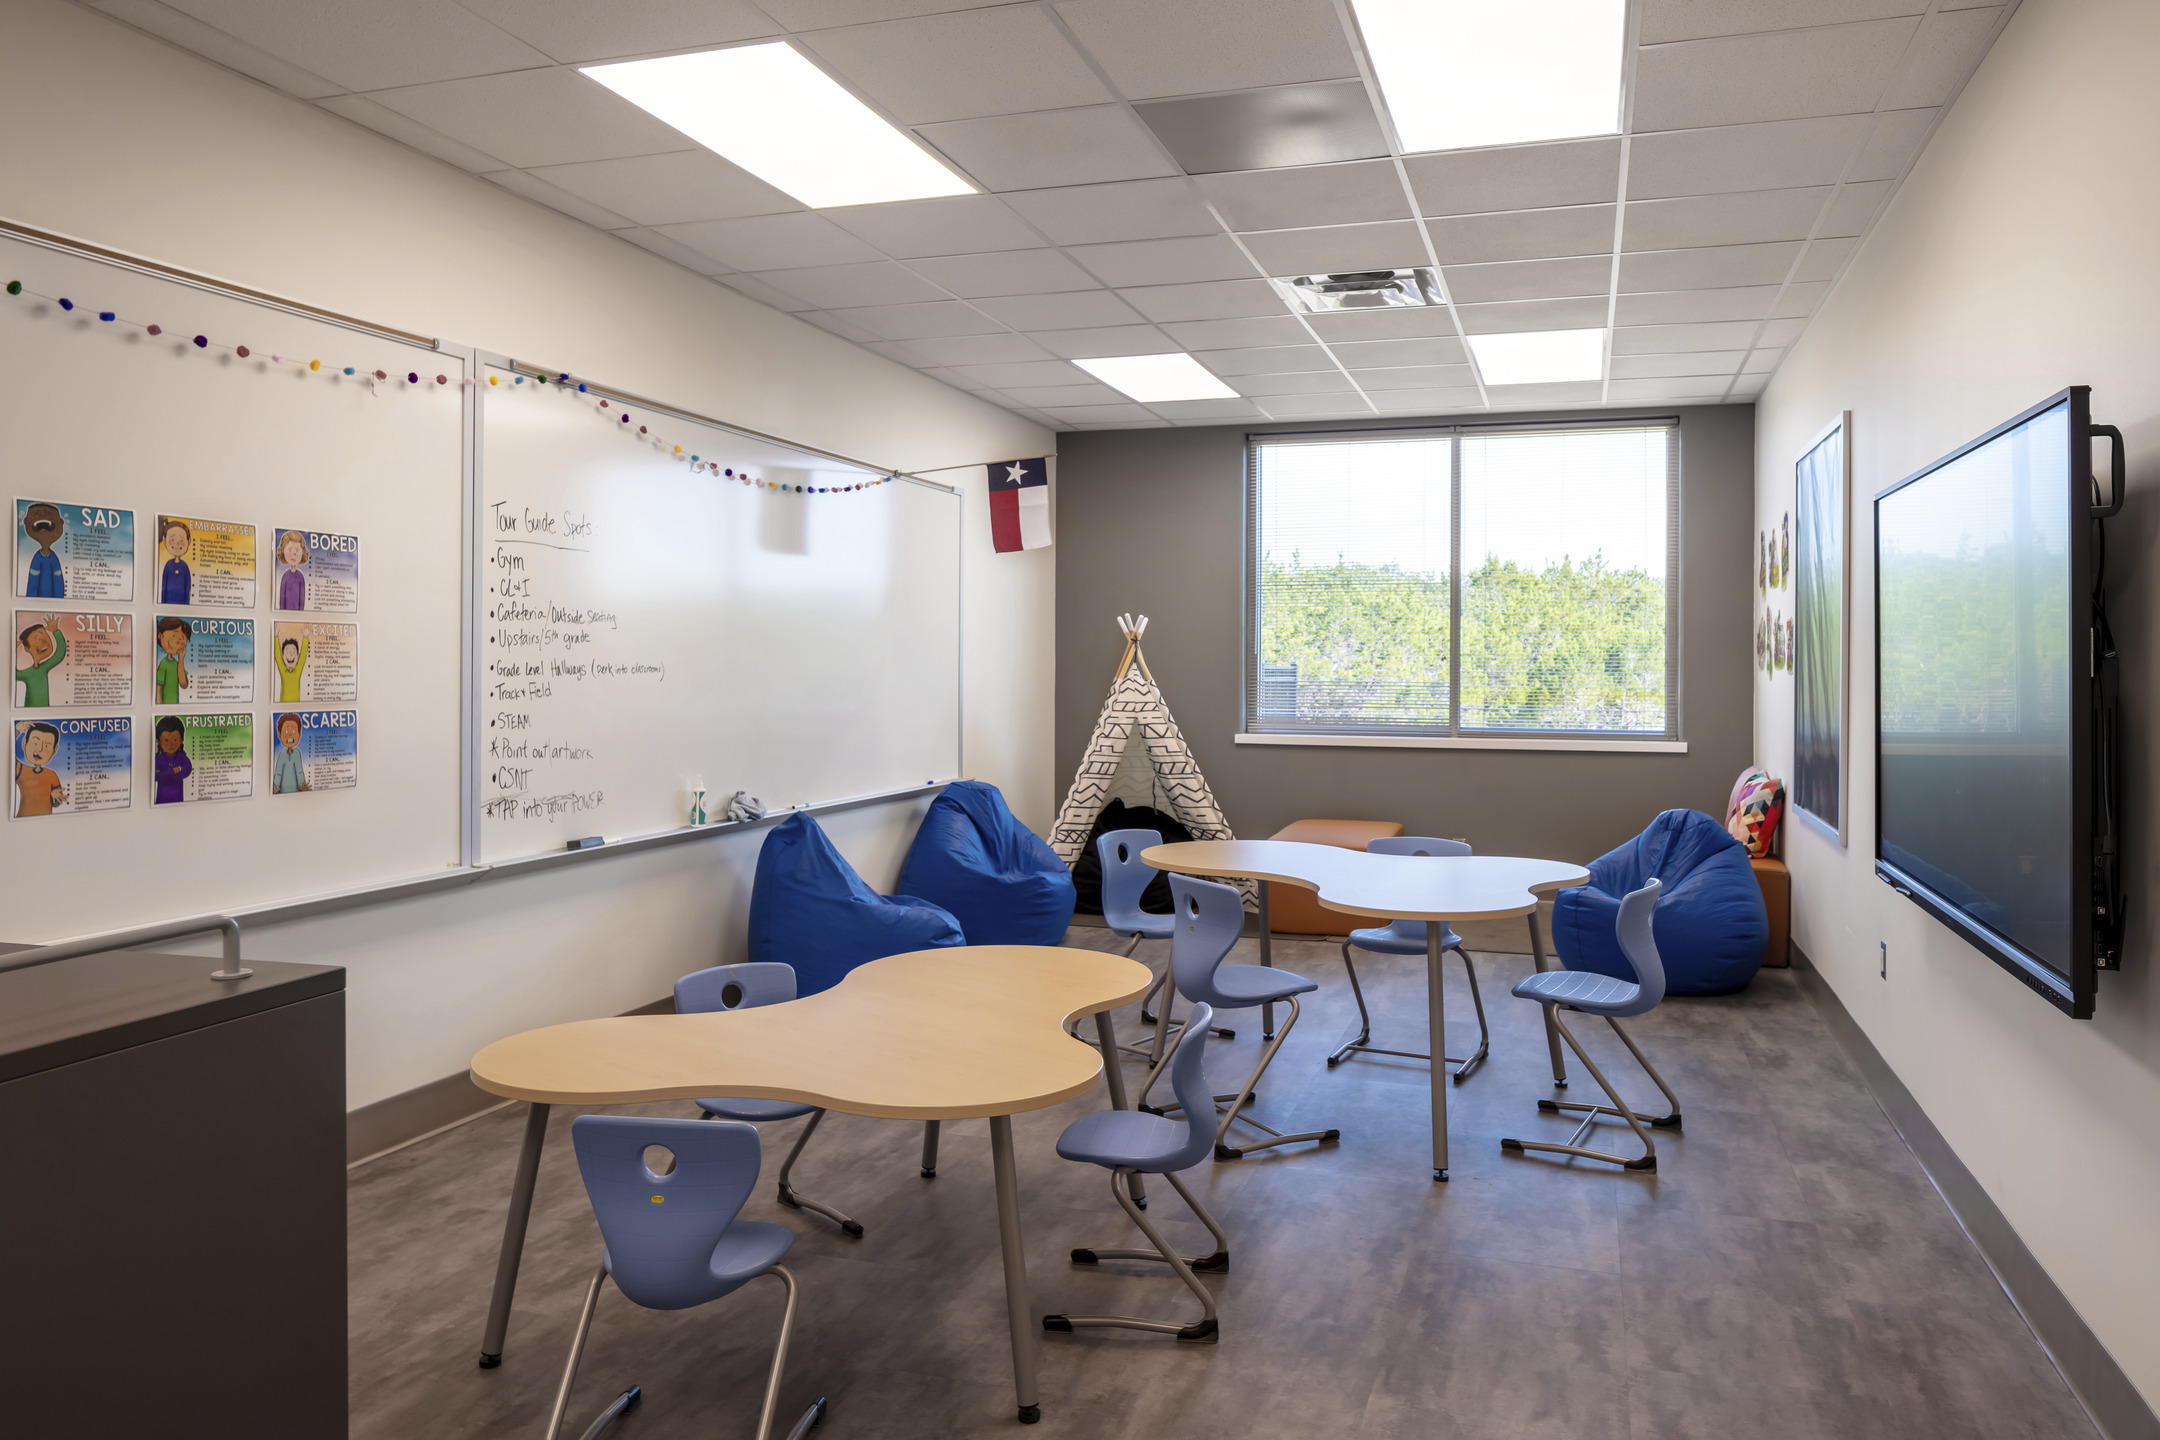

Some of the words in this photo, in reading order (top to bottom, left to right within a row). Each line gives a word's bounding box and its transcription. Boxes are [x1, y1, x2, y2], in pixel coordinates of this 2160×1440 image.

[81, 507, 121, 529] SAD
[491, 501, 517, 532] Tour
[525, 507, 556, 534] Guide
[189, 520, 255, 536] EMBARRASSED
[310, 533, 357, 552] BORED
[497, 546, 525, 576] Gym
[75, 614, 124, 633] SILLY
[191, 619, 253, 636] CURIOUS
[312, 624, 356, 637] EXCITED
[563, 629, 591, 650] grade
[496, 660, 521, 677] Grade
[550, 658, 587, 681] Hallways
[528, 681, 552, 700] Field
[60, 719, 130, 734] CONFUSED
[185, 715, 251, 728] FRUSTRATED
[302, 711, 356, 729] SCARED
[497, 711, 531, 730] STEAM
[502, 737, 527, 758] Point
[532, 740, 549, 758] out
[551, 741, 594, 760] artwork
[494, 798, 518, 821] TAP
[523, 798, 543, 819] into
[546, 798, 568, 823] your
